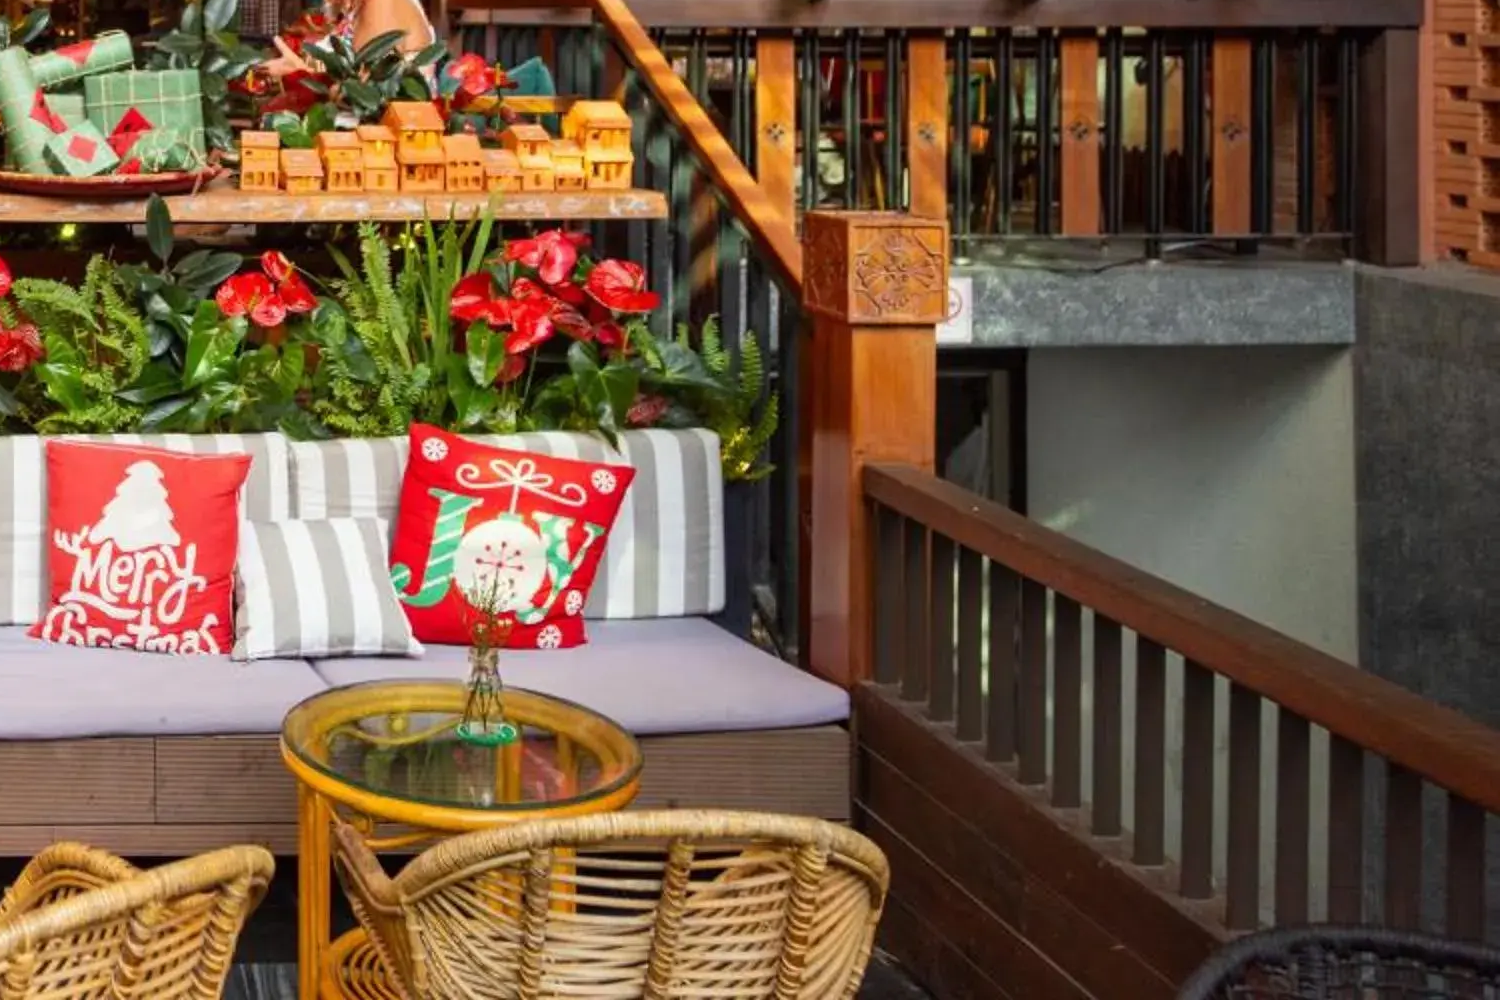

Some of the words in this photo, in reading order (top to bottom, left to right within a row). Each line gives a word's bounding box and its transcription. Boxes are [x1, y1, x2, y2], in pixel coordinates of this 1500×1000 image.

[56, 537, 208, 625] Merry
[391, 486, 605, 625] JOY
[41, 602, 221, 656] Chrstmas
